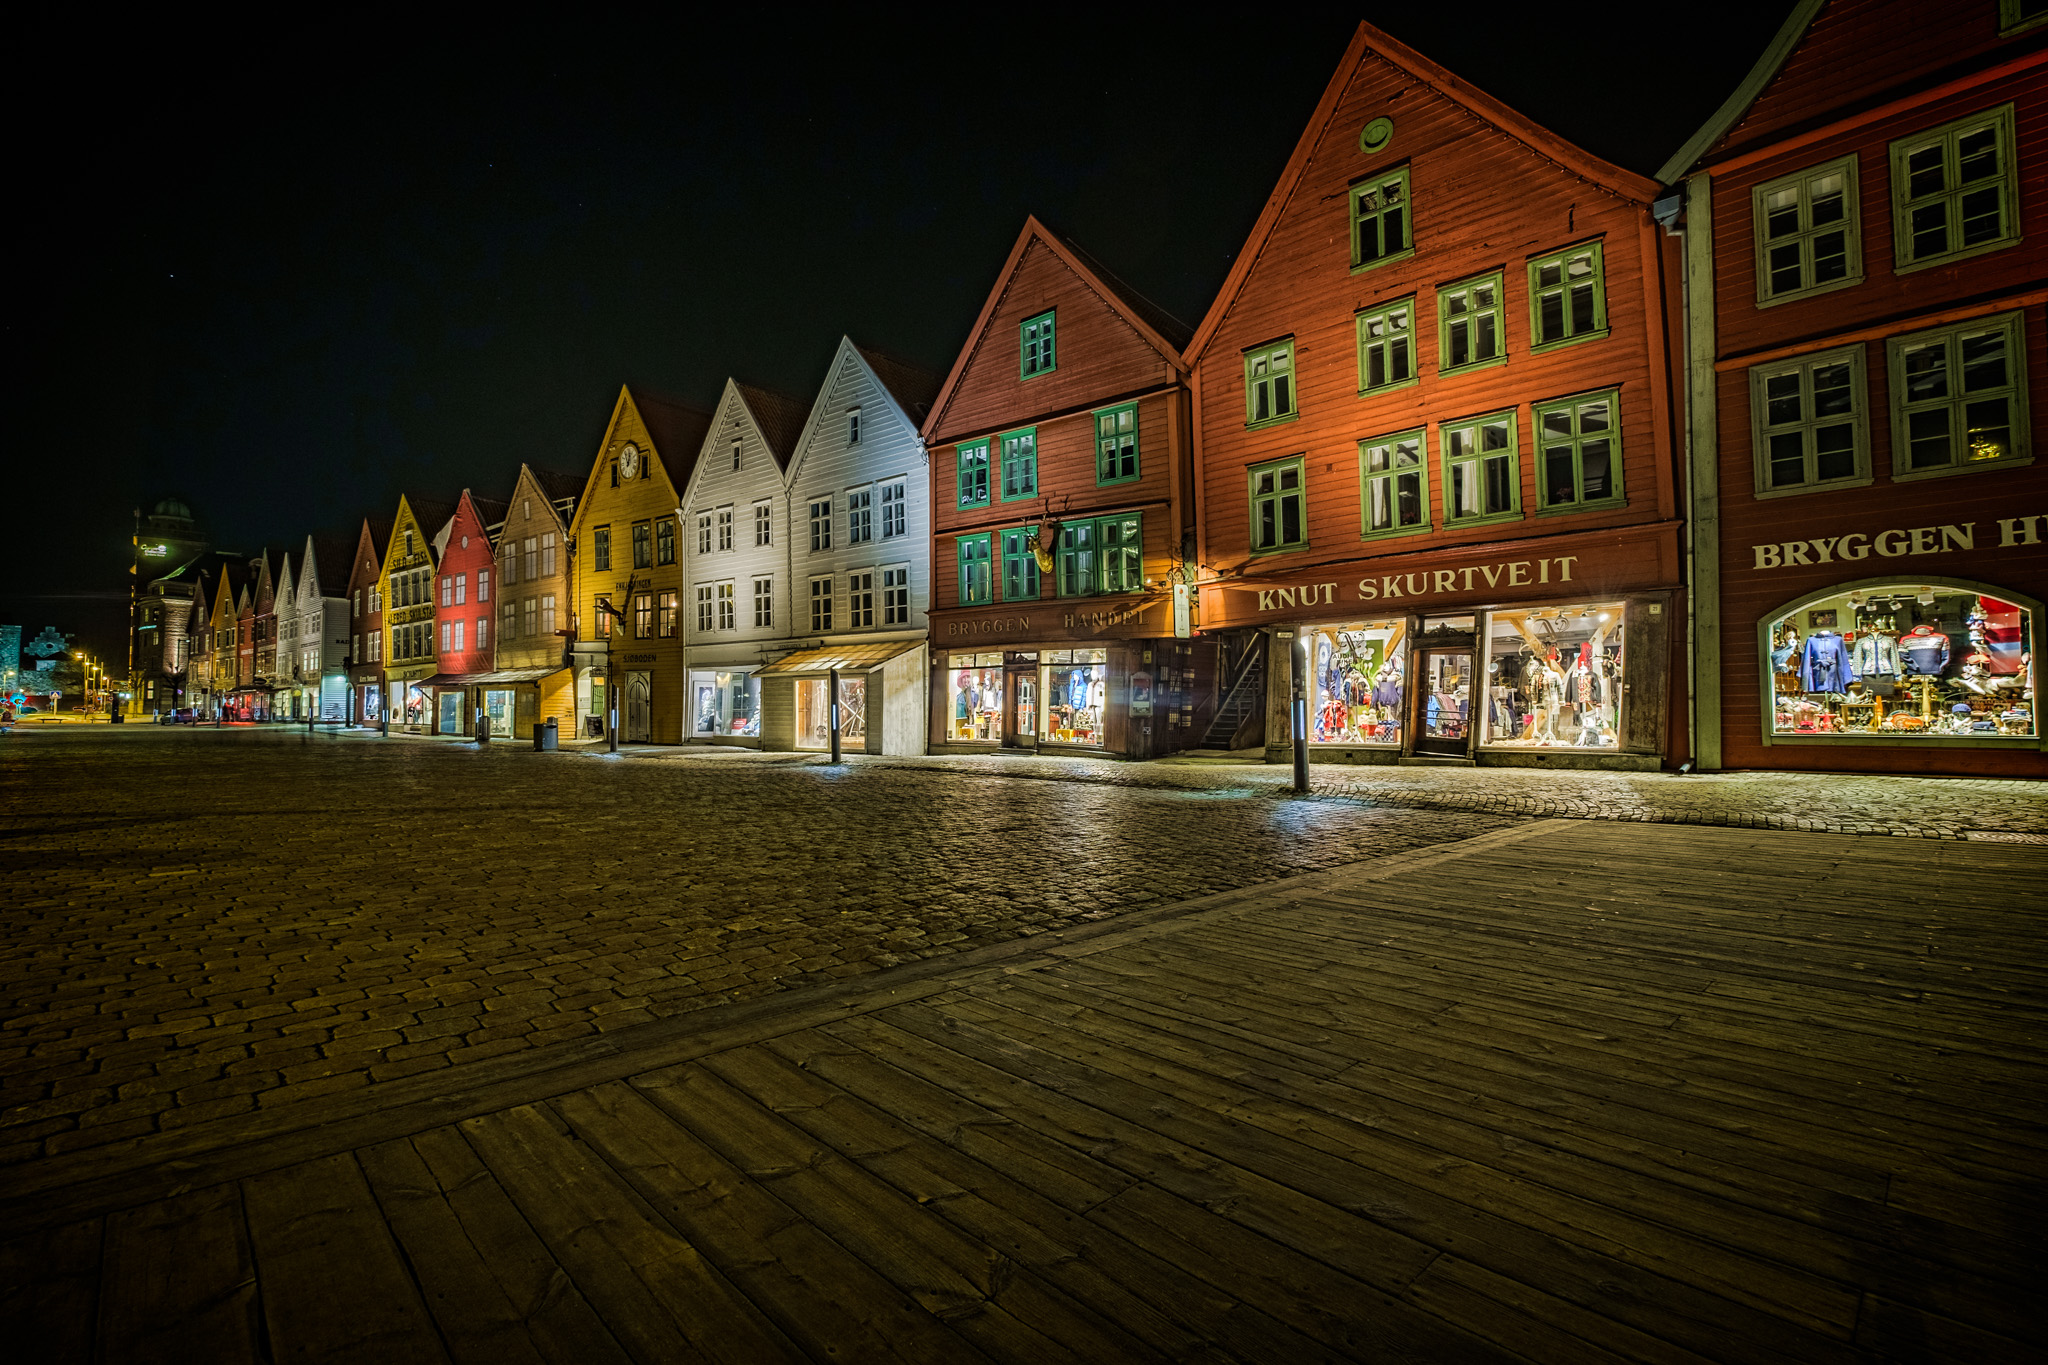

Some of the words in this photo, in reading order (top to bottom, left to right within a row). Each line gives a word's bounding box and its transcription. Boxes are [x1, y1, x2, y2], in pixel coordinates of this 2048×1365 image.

[1752, 522, 1975, 569] BRYGGEN
[1996, 514, 2048, 547] H
[1258, 582, 1338, 611] KNUT
[1358, 556, 1578, 600] SKURTVEIT
[948, 616, 1030, 637] BRYGGEN
[1063, 610, 1151, 629] HANDEL
[623, 654, 657, 663] SJØBODEN
